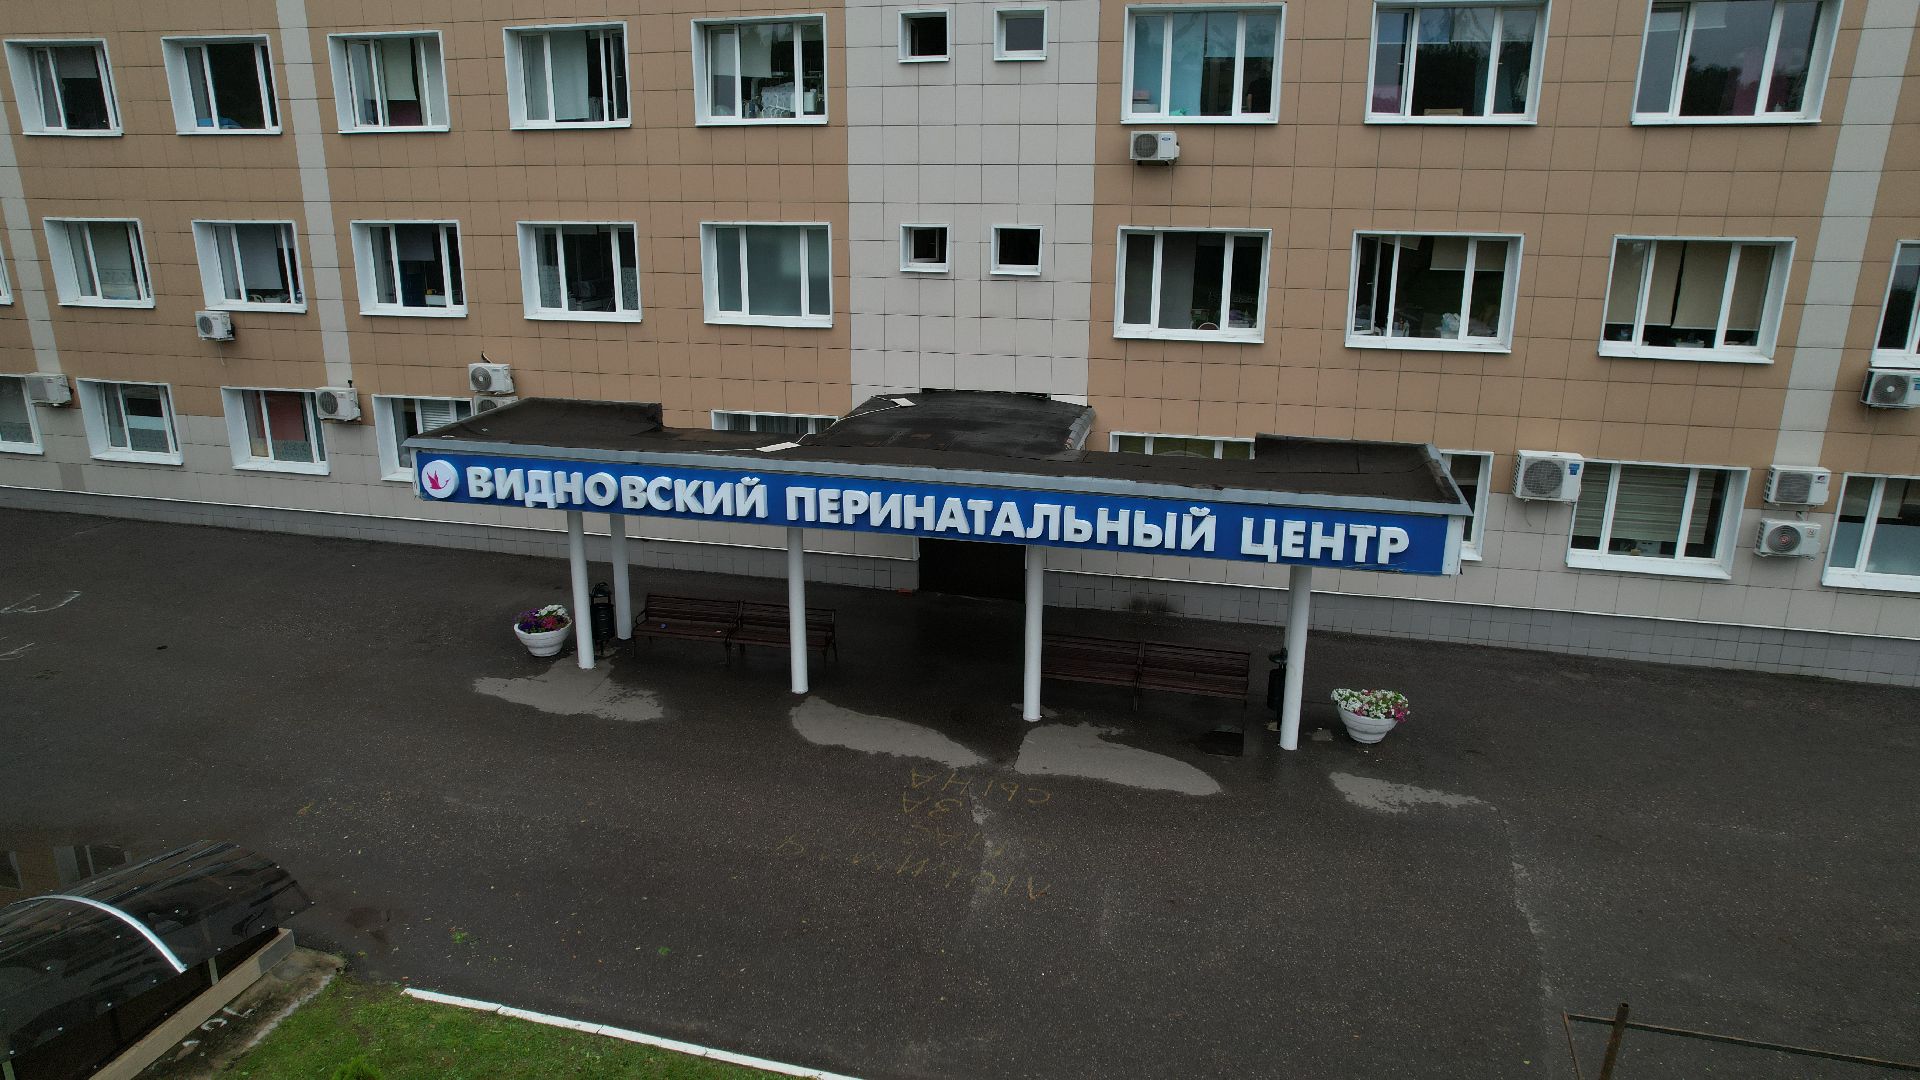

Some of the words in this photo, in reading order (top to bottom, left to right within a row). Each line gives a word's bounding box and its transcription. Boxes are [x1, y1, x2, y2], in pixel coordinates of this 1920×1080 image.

[466, 465, 769, 519] ВИДНОВСКИЙ
[785, 486, 1217, 552] ПЕРИНАТАЛЬНЫЙ
[1240, 516, 1410, 565] ЦЕНТР
